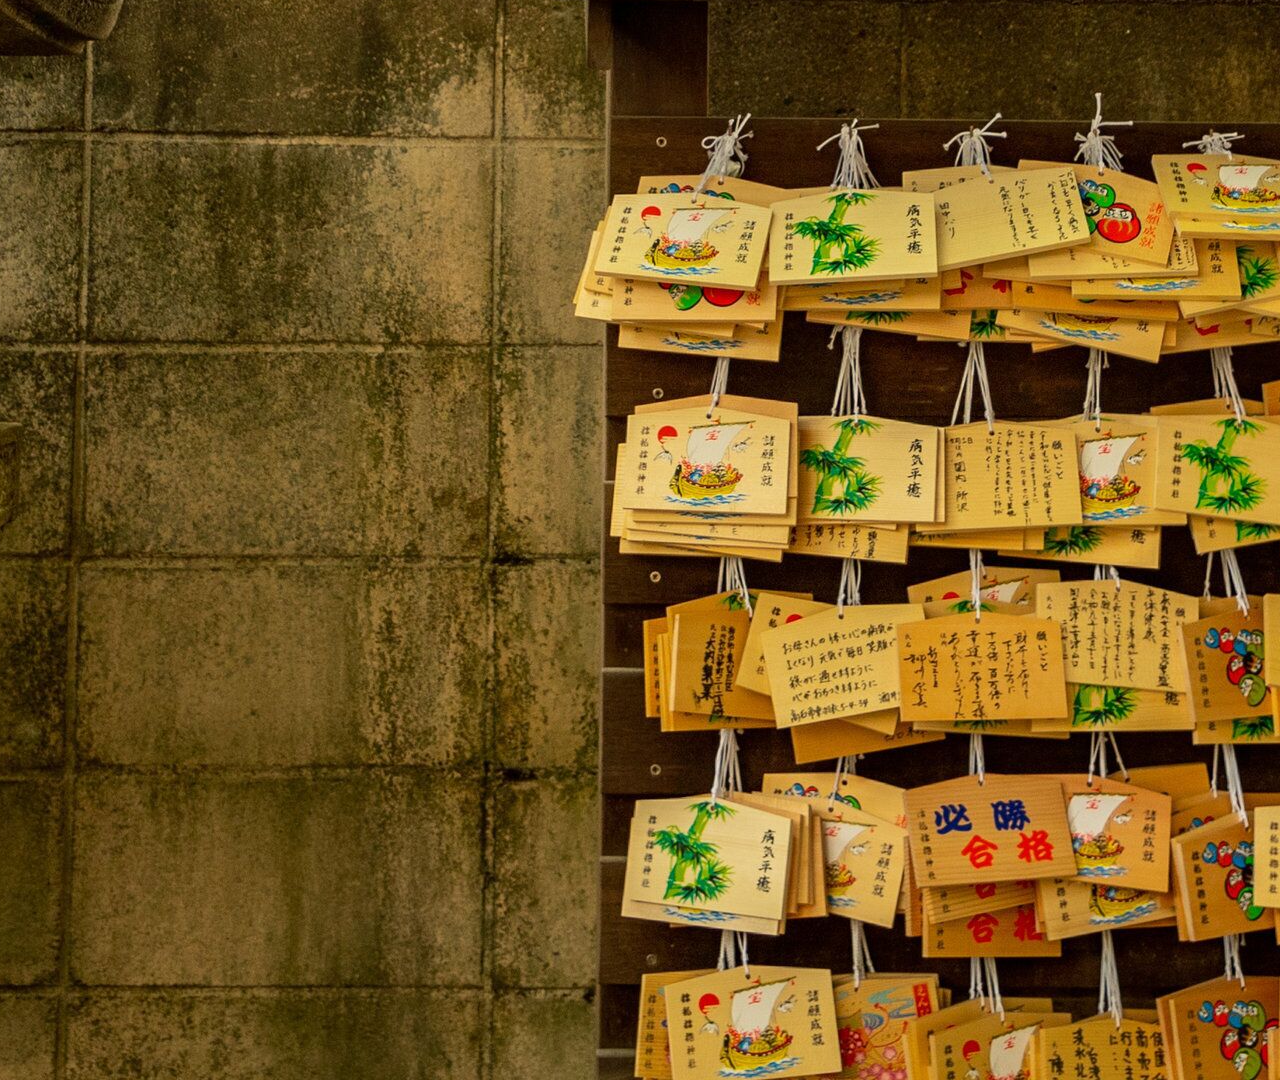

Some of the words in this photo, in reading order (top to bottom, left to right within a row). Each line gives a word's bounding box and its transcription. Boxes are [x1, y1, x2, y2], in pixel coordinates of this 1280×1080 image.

[735, 220, 753, 264] 諸願成就
[906, 204, 922, 255] 病気平癒
[1137, 202, 1164, 251] 諸願成就
[760, 435, 776, 487] 諸願成就
[907, 438, 923, 498] 病気平癒
[1036, 631, 1048, 671] 願いごと
[934, 799, 1031, 835] 必勝
[1142, 810, 1156, 863] 諸願成就
[757, 829, 776, 893] 病気平癒
[873, 842, 893, 898] 諸願成就
[961, 830, 1054, 869] 合格
[806, 990, 825, 1046] 諸願成就
